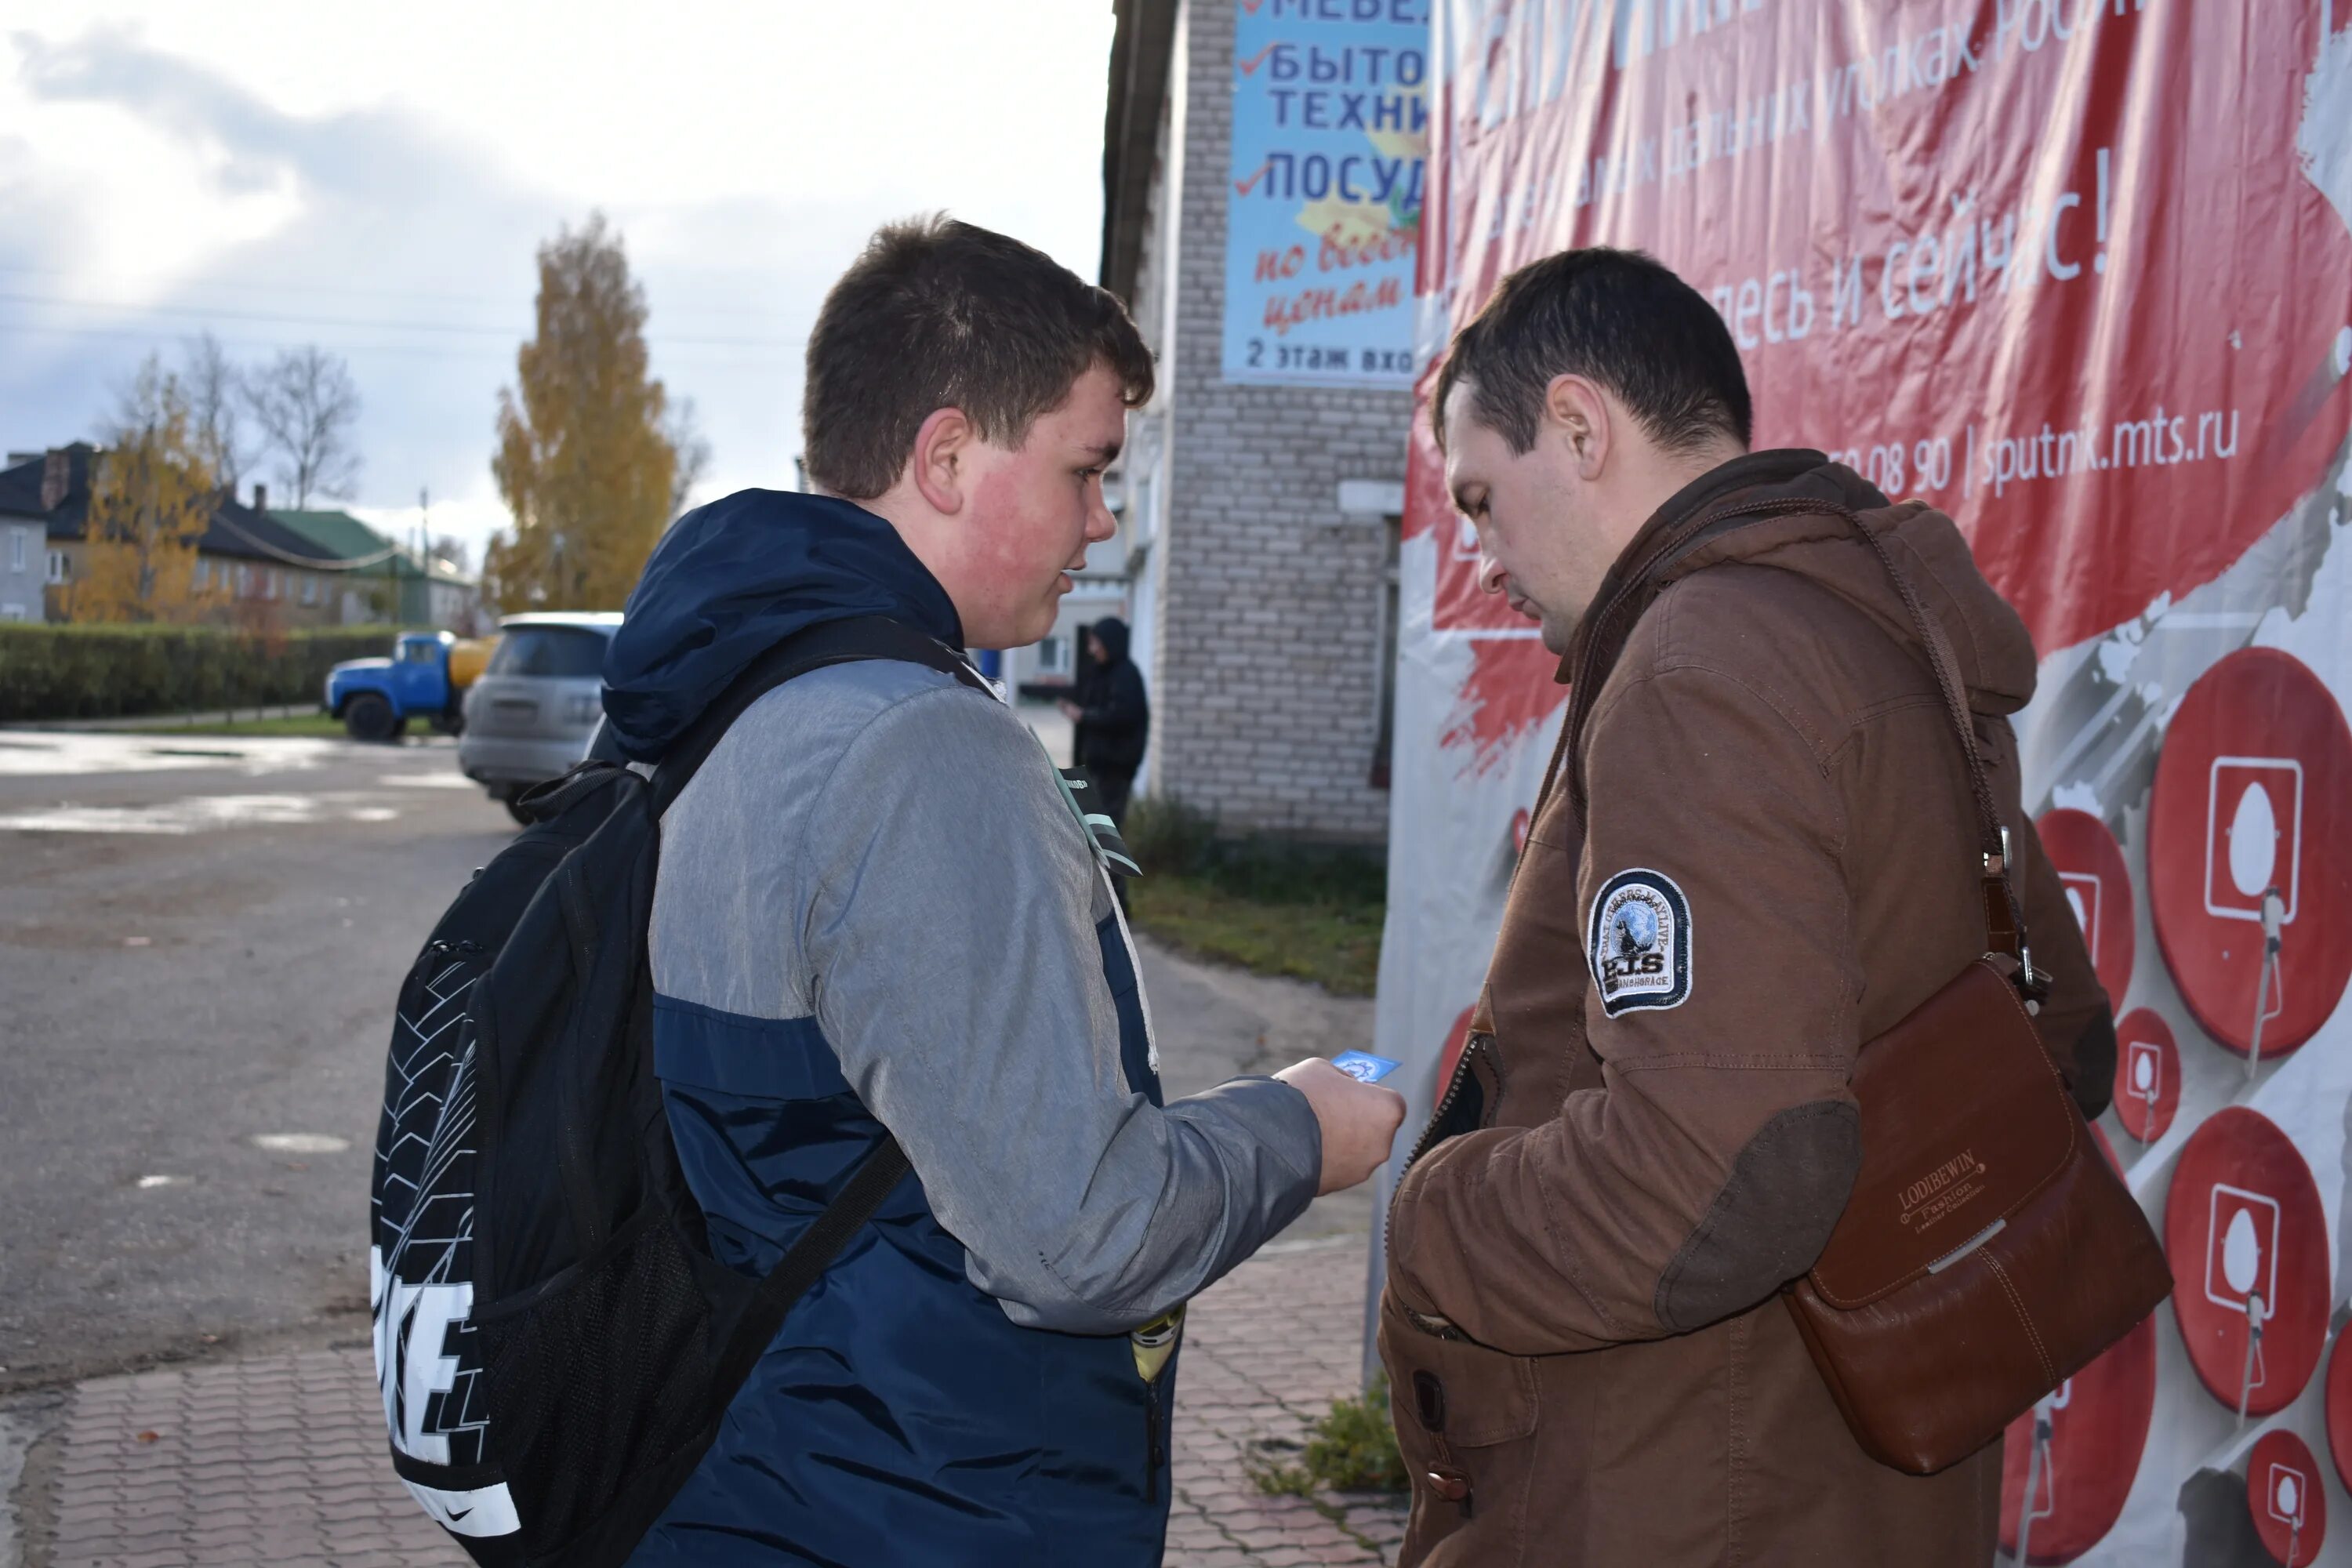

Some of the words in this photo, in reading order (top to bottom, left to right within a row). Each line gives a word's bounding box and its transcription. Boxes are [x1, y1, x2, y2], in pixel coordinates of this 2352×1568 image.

[1273, 0, 1428, 24] МЕБЕ
[1256, 245, 1305, 284] по
[1712, 267, 1815, 350] есь
[1831, 252, 1863, 330] и
[1882, 147, 2111, 320] сейчас!
[1247, 338, 1264, 368] 2
[1278, 345, 1348, 369] этаж
[1913, 435, 1952, 494] 90
[1898, 1148, 1976, 1210] LODIBEWIN
[1921, 1182, 1973, 1220] Fashion
